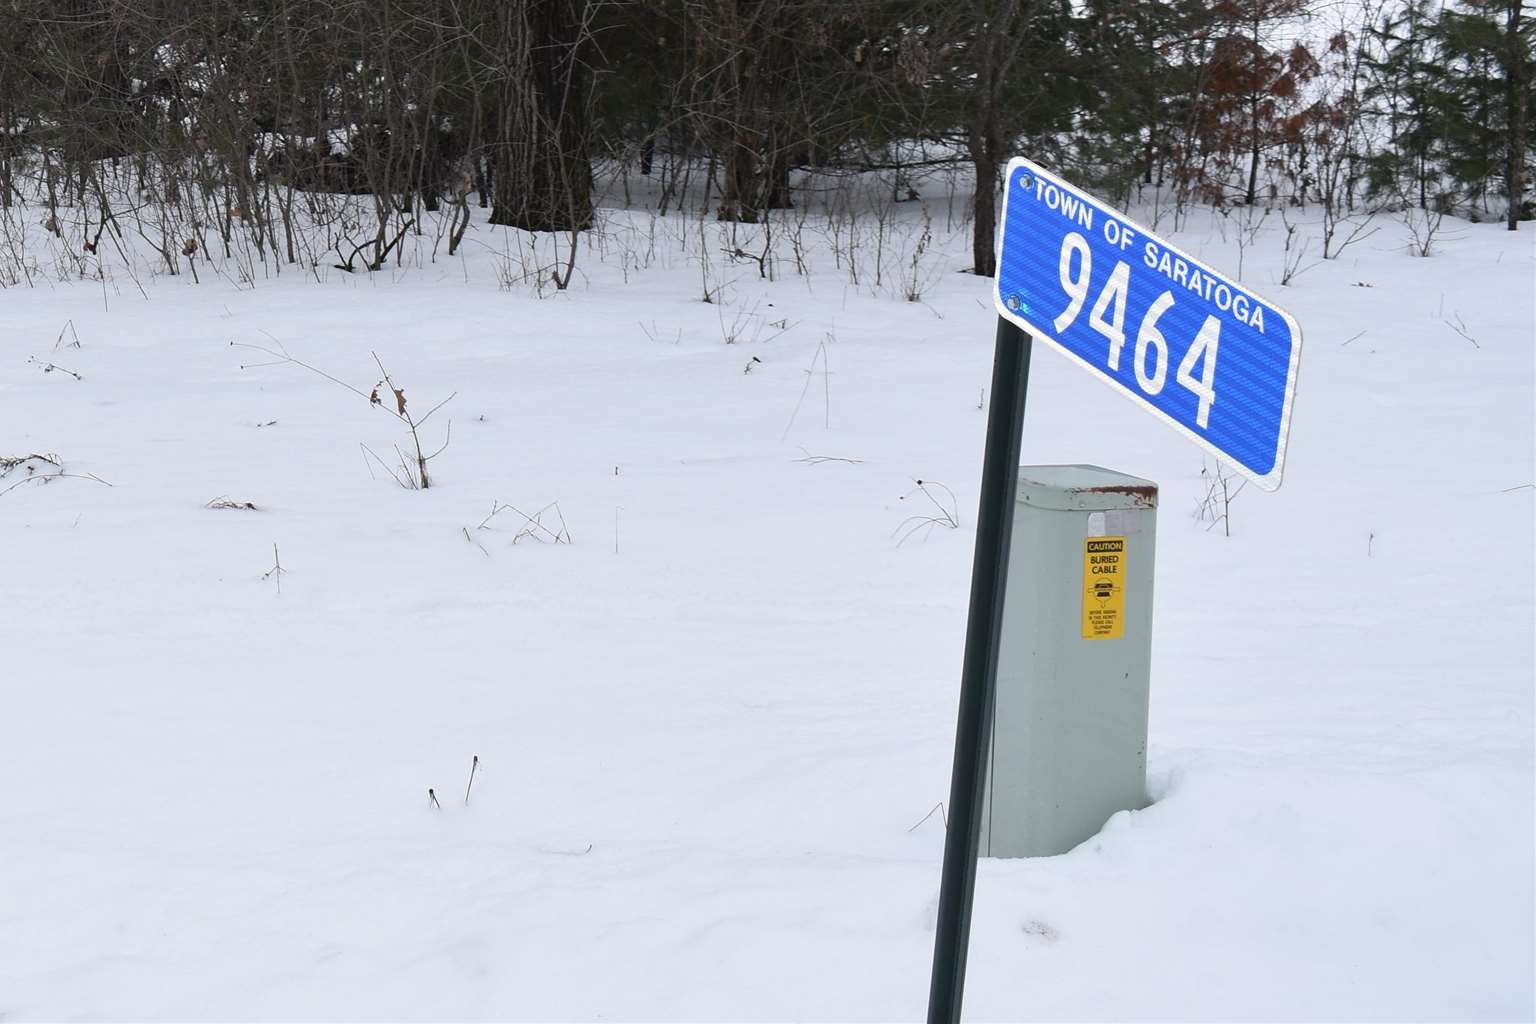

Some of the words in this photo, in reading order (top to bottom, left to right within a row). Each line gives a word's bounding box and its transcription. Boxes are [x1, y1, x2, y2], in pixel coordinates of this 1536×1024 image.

[1034, 176, 1093, 230] TOWN
[1103, 223, 1135, 250] OF
[1143, 242, 1265, 333] SARATOGA
[1054, 231, 1222, 430] 9464
[1088, 542, 1122, 551] CAUTION
[1090, 555, 1119, 564] BURIED
[1091, 565, 1118, 574] CABLE
